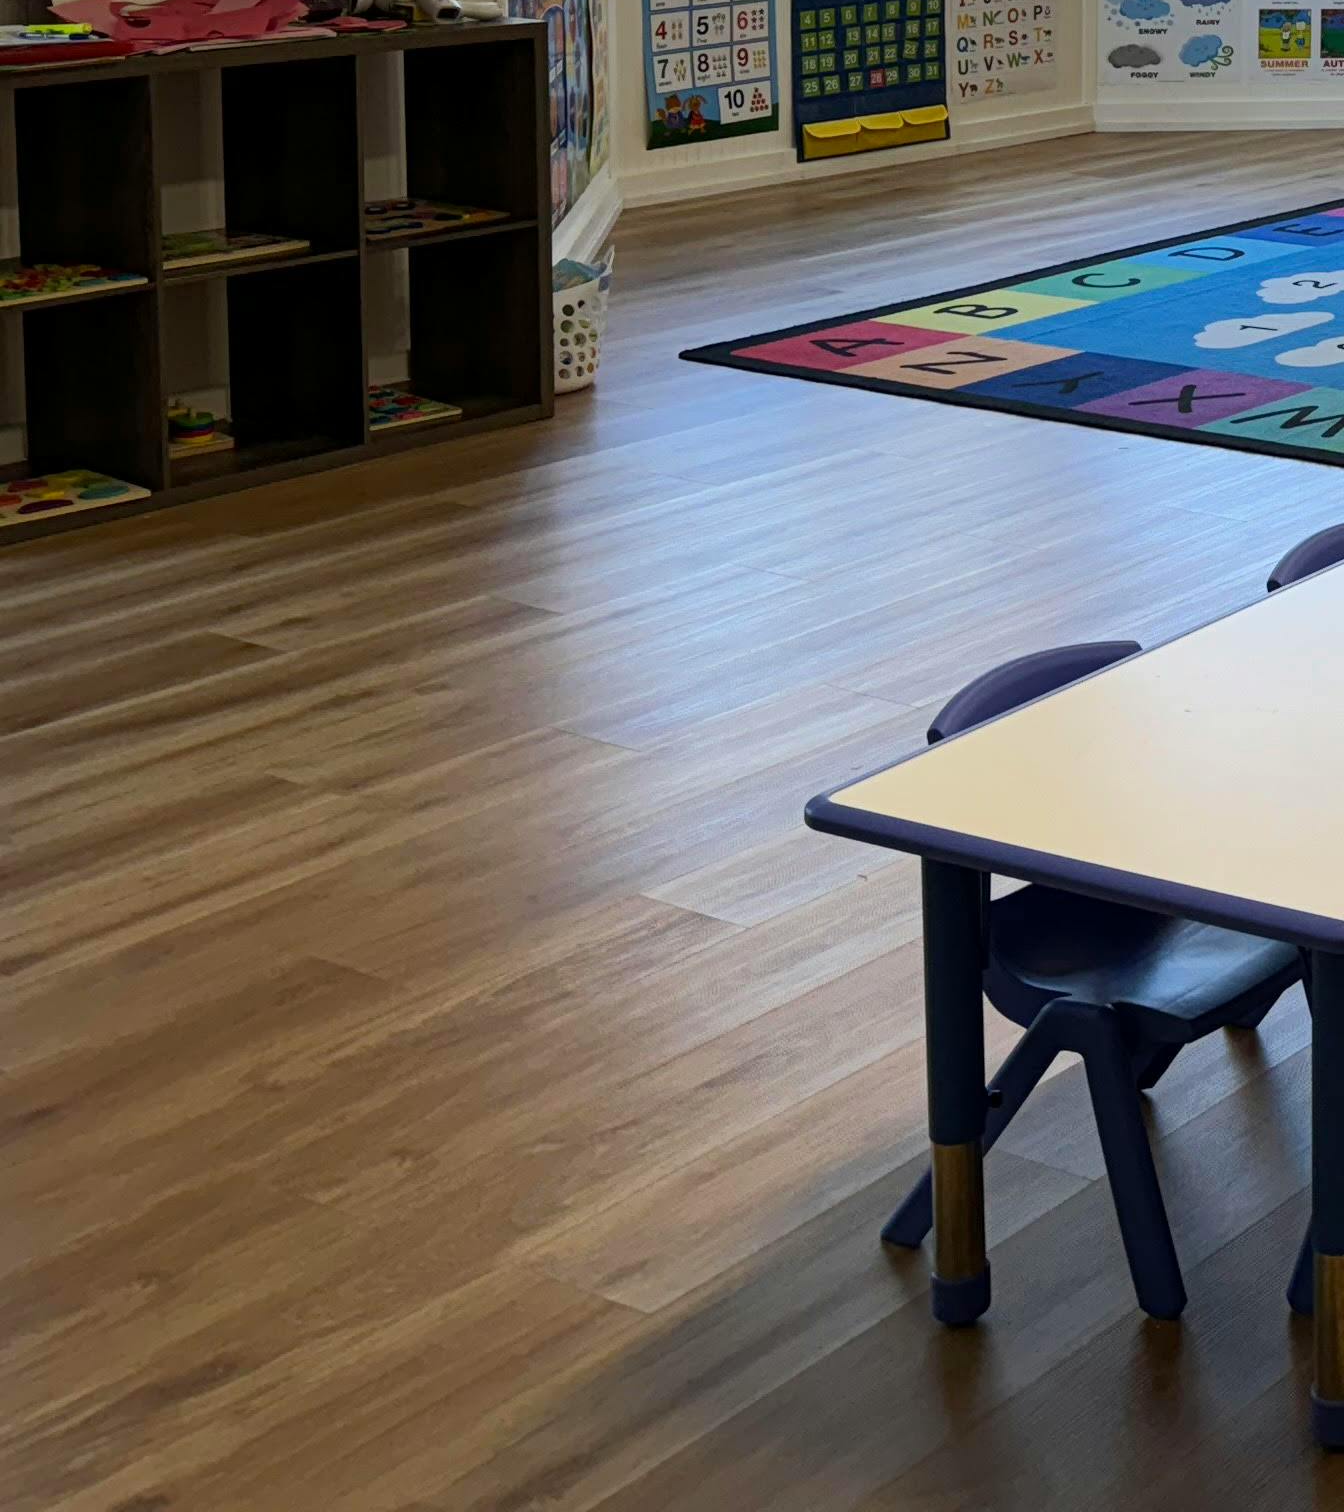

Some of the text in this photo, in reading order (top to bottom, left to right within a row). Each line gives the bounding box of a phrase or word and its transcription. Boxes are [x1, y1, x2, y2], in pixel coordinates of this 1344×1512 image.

[696, 15, 709, 36] 5
[737, 10, 749, 30] 6
[983, 11, 994, 27] N
[1007, 7, 1019, 23] O
[1033, 5, 1043, 21] P
[655, 20, 668, 40] 4
[957, 26, 1043, 53] Q R S T
[697, 53, 710, 73] 8
[737, 47, 749, 67] 9
[844, 54, 857, 65] 20
[958, 49, 1044, 75] U V W X
[1260, 59, 1310, 68] SUMMER
[657, 59, 669, 79] 7
[1130, 71, 1159, 79] FOGGY
[805, 82, 818, 94] 25
[825, 79, 839, 90] 26
[849, 76, 861, 87] 27
[958, 79, 994, 98] Y Z
[724, 88, 745, 109] 10
[811, 337, 905, 357] A
[933, 303, 1019, 320] B
[1071, 272, 1141, 289] C
[1168, 246, 1246, 262] D
[1271, 223, 1344, 237] E
[1292, 279, 1340, 289] 2
[1239, 324, 1279, 332] 1
[900, 350, 1008, 376] Z
[1011, 370, 1105, 394] Y
[1128, 383, 1247, 415] X
